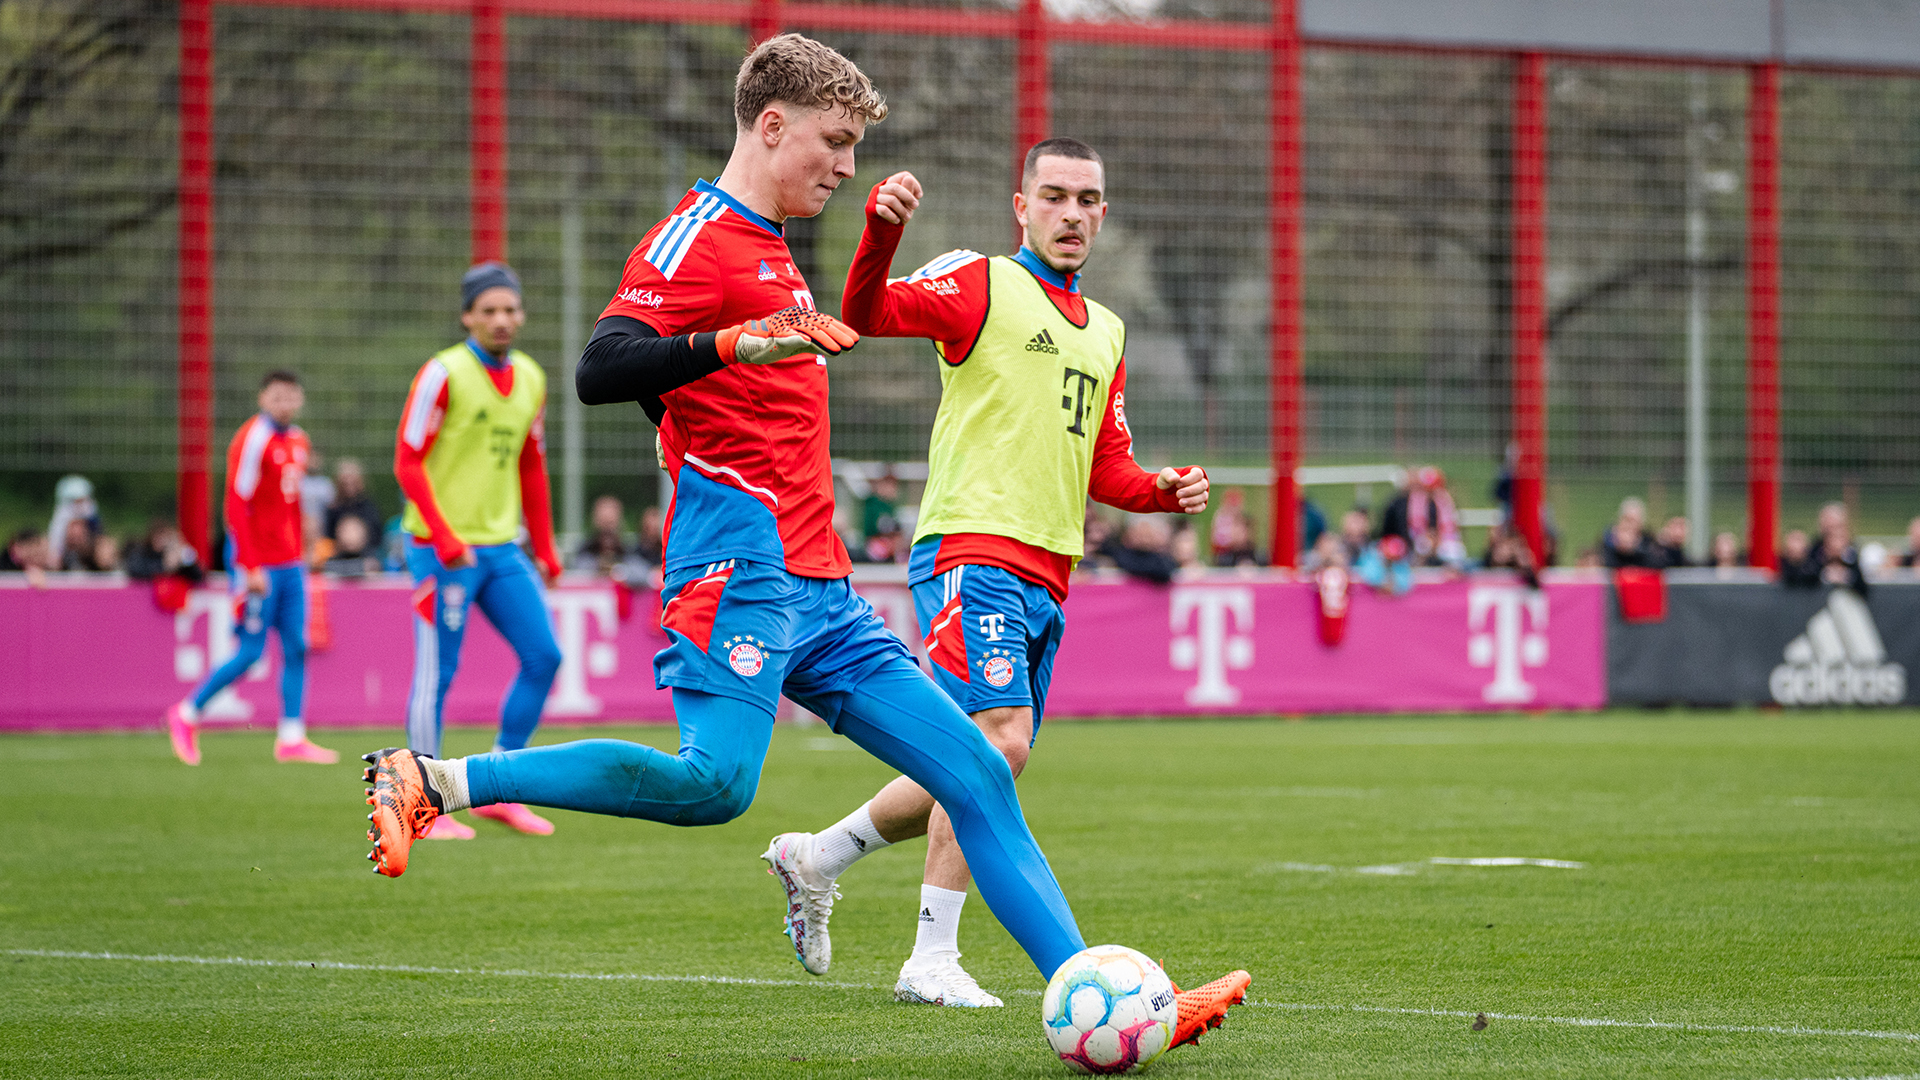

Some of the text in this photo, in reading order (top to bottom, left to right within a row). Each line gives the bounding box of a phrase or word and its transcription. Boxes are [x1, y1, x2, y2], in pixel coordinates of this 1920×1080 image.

[1025, 343, 1060, 356] adidas
[1061, 366, 1099, 439] T
[979, 613, 1005, 642] T
[1170, 586, 1254, 707] T
[1468, 586, 1549, 704] T
[1769, 662, 1907, 706] adidas
